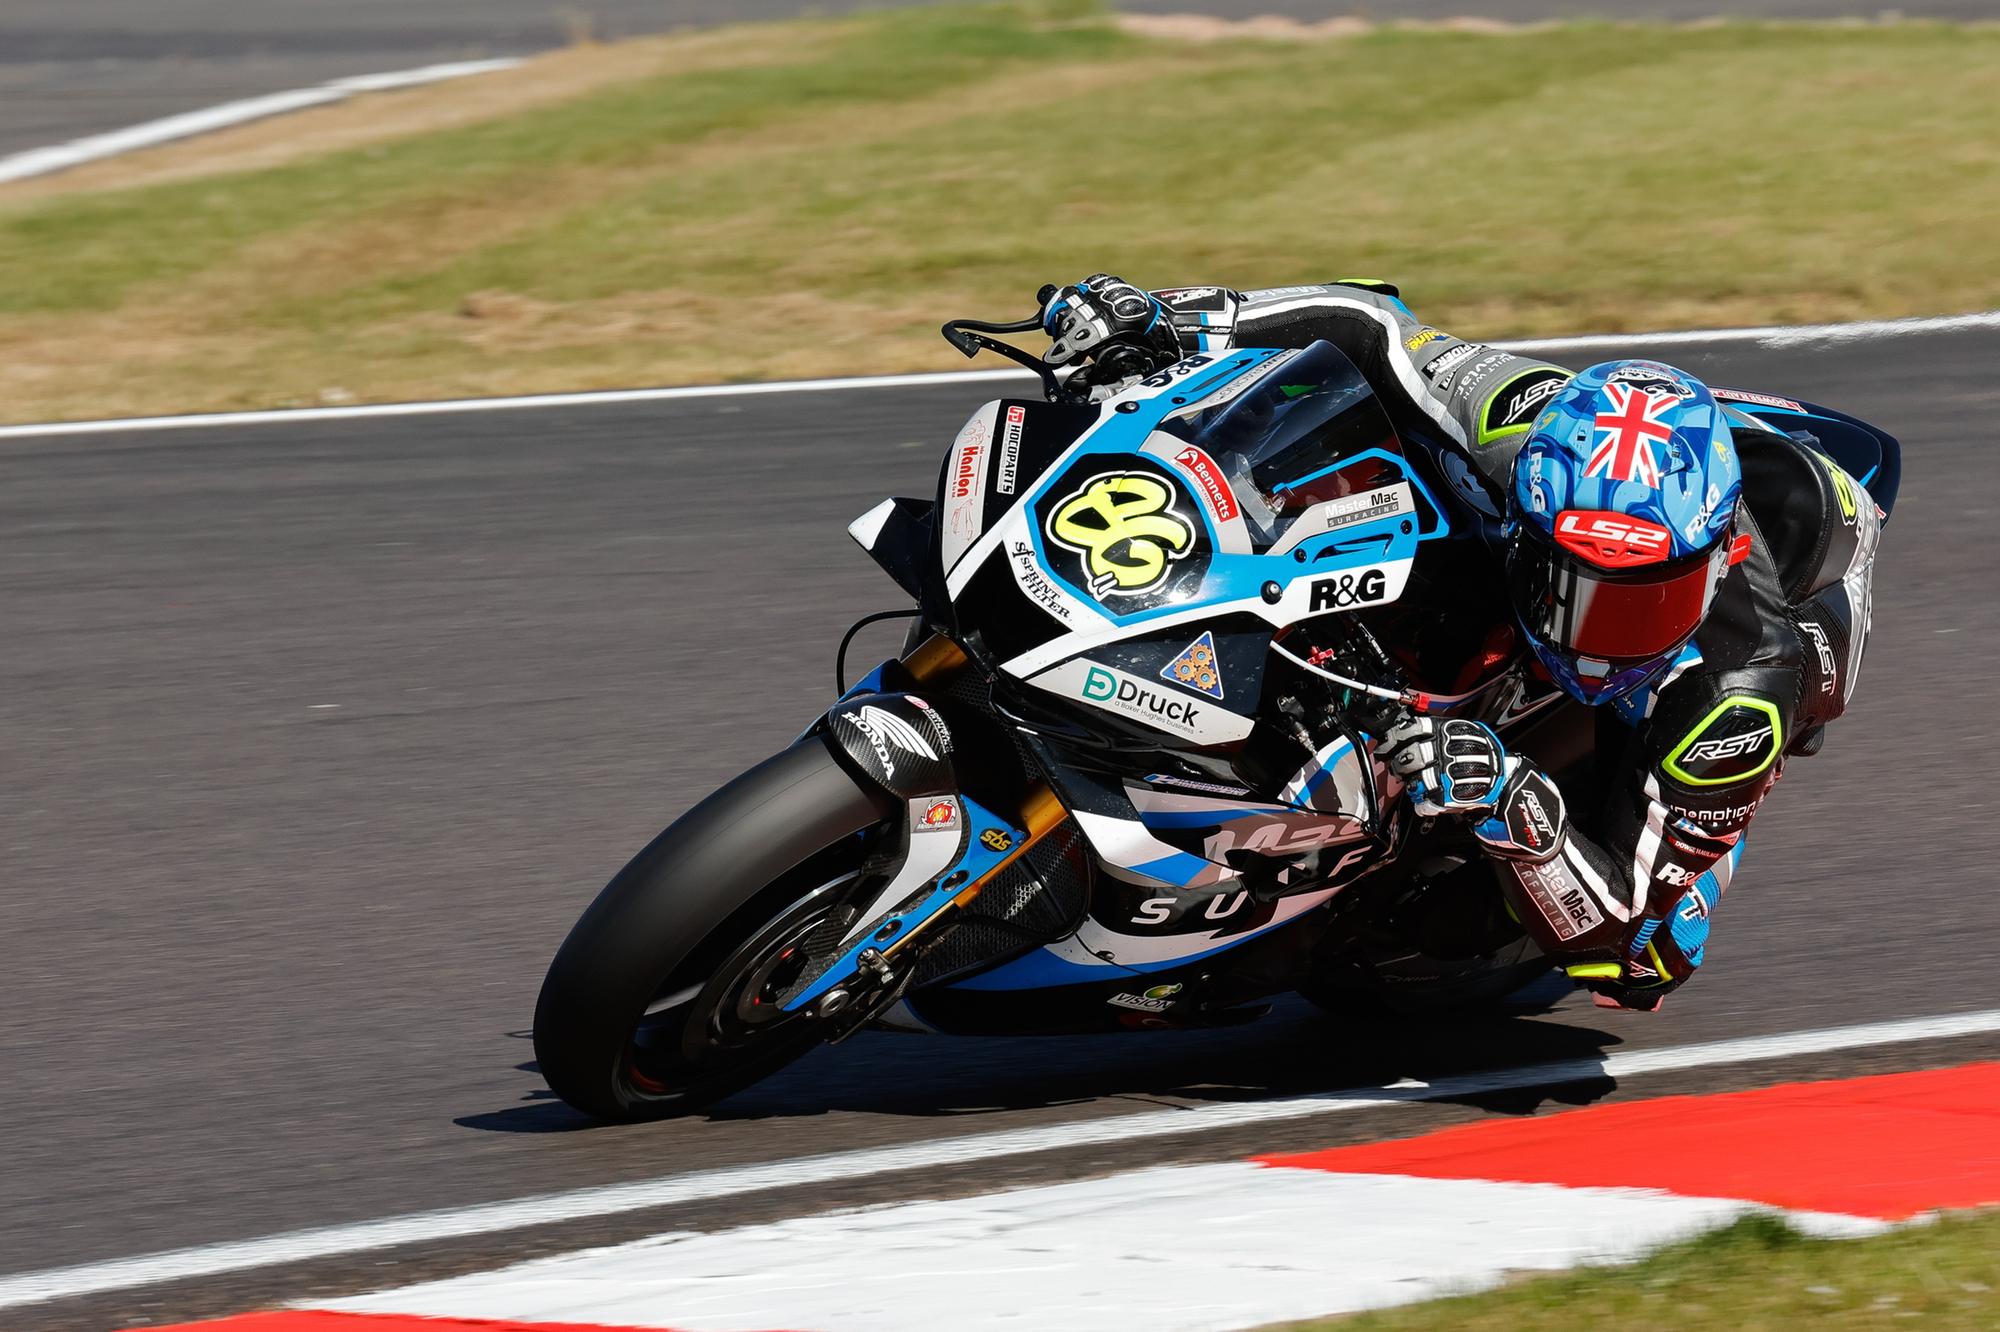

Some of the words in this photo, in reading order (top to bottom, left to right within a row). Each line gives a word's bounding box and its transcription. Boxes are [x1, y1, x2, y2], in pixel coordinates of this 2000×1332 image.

[1140, 356, 1214, 388] R&G
[1463, 372, 1488, 400] WITH
[1501, 377, 1571, 425] RST
[957, 446, 978, 497] Hanlon
[1003, 424, 1020, 493] HOCOPARTS
[1195, 462, 1229, 518] Bennetts
[1325, 492, 1398, 518] MasterMac
[1530, 452, 1546, 513] R&G
[1050, 472, 1192, 592] 86
[1329, 504, 1398, 527] SURFACING
[1559, 514, 1669, 548] LS2
[1685, 483, 1720, 544] R&G
[1021, 557, 1060, 600] SPRINT
[1021, 574, 1070, 618] FILTER
[1309, 569, 1386, 613] R&G
[1117, 679, 1200, 728] Druck
[1141, 709, 1165, 723] Hughes
[1166, 719, 1194, 734] business
[841, 711, 895, 781] HONDA
[1682, 725, 1772, 763] RST
[1521, 789, 1555, 837] RST
[1540, 862, 1593, 929] sterMac
[1656, 862, 1695, 886] R&
[1517, 862, 1573, 937] RFACING
[1117, 993, 1171, 1009] VISION
